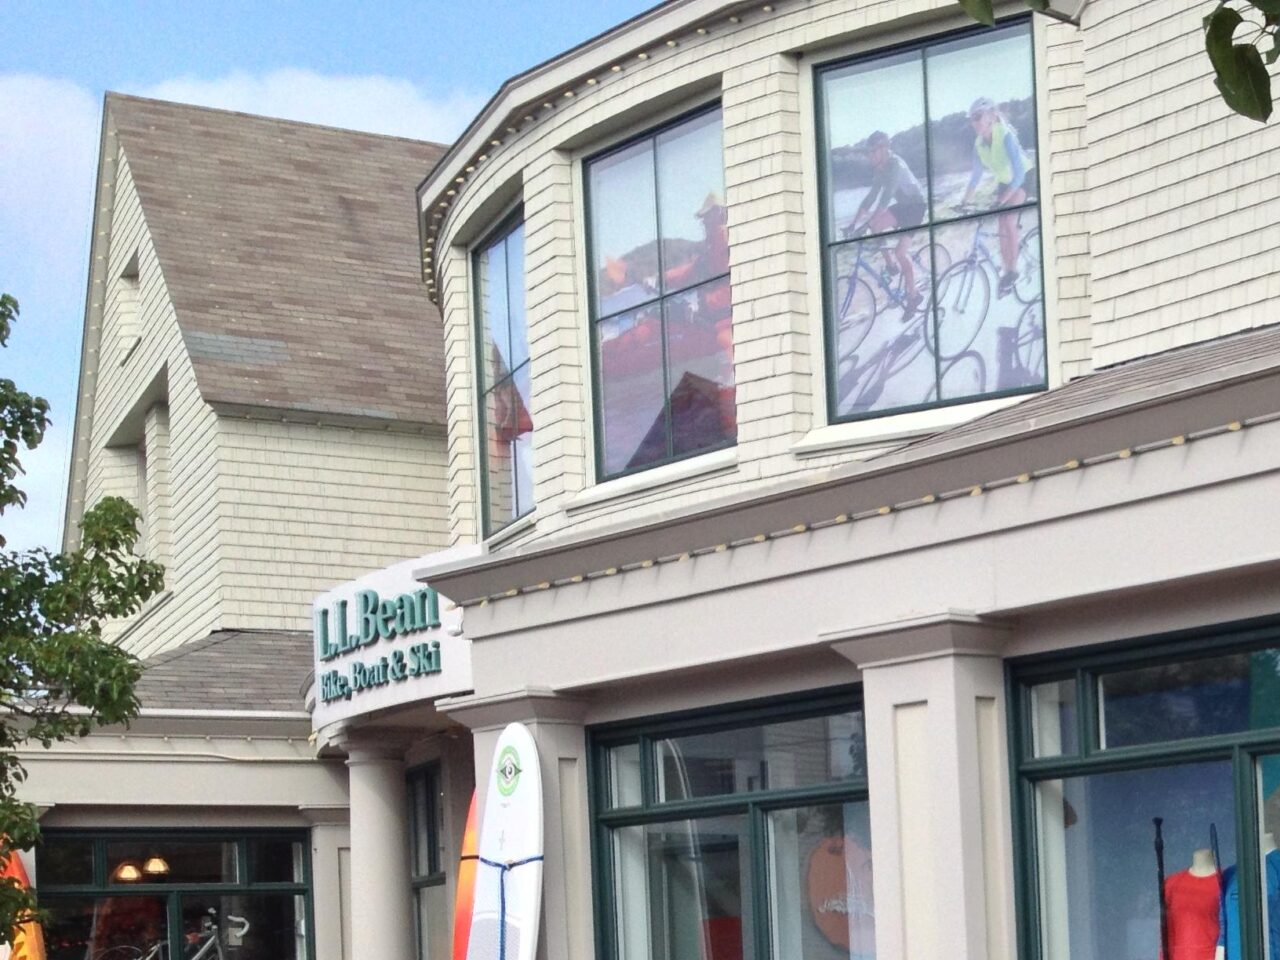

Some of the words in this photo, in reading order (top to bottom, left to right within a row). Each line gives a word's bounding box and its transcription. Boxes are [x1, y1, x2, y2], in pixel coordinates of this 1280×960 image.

[316, 587, 441, 662] L.L.Bean
[320, 669, 353, 702] Bike,
[350, 656, 390, 692] Boat
[388, 649, 409, 681] &
[408, 640, 442, 677] Ski
